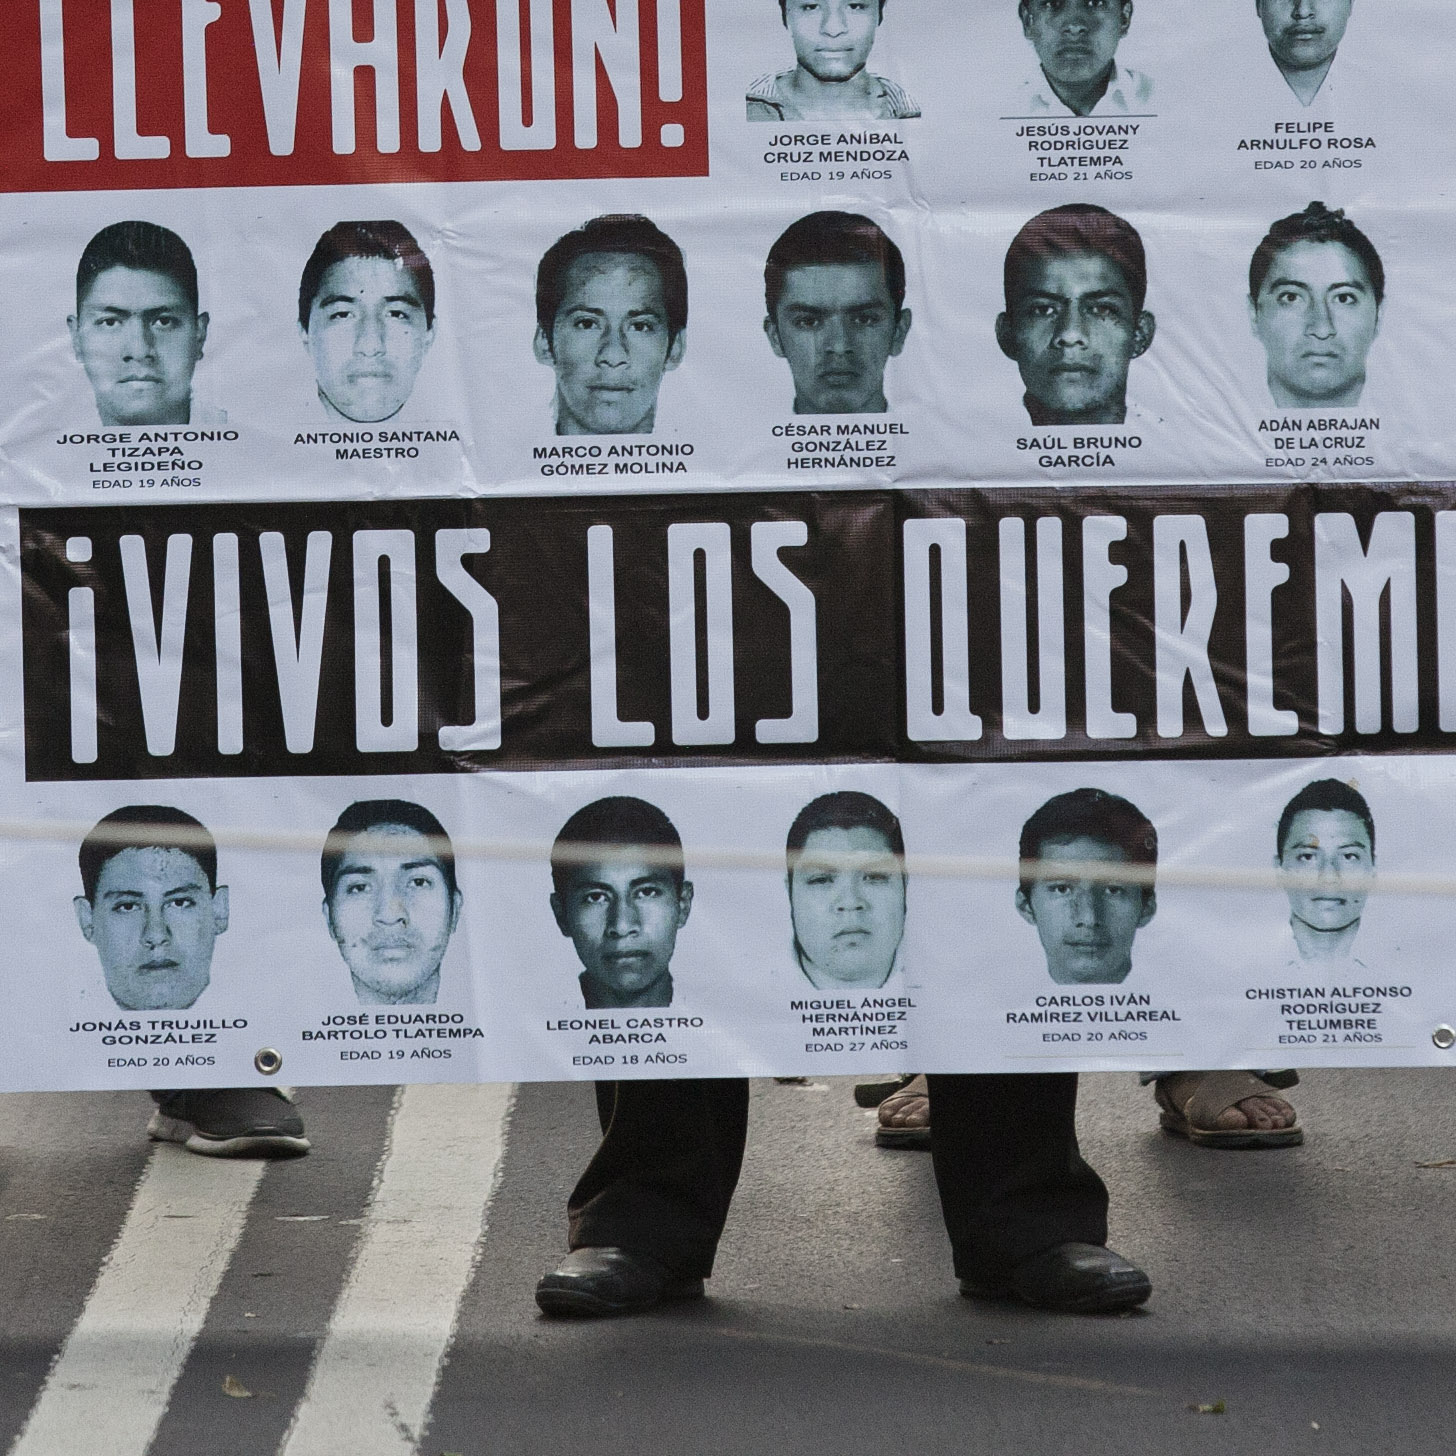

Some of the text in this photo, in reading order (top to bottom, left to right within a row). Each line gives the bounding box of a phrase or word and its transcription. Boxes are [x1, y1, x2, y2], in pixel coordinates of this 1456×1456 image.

[1015, 122, 1140, 137] JESÚS JOVANY
[1274, 122, 1335, 134] FELIPE
[768, 129, 904, 147] JORGE ANÍBAL
[1028, 136, 1129, 151] RODRÍGUEZ
[1236, 137, 1377, 150] ARNULFO ROSA
[763, 149, 910, 163] CRUZ MENDOZA
[1036, 156, 1124, 168] TLATEMPA
[1254, 157, 1363, 170] EDAD 20 AÑOS
[771, 422, 910, 437] CÉSAR MANUEL
[1258, 416, 1303, 432] ADÁN
[293, 430, 460, 444] ANTONIO SANTANA
[1016, 434, 1143, 450] SAÚL BRUNO
[1274, 435, 1366, 450] DE LA CRUZ
[533, 443, 695, 459] MARCO ANTONIO
[791, 437, 888, 453] GONZÁLEZ
[335, 447, 419, 459] MAESTRO
[1038, 451, 1116, 469] GARCÍA
[540, 459, 688, 476] GÓMEZ MOLINA
[787, 453, 897, 469] HERNÁNDEZ
[65, 527, 503, 764] ¡VIVOS
[586, 520, 820, 748] LOS
[1035, 992, 1151, 1007] CARLOS IVÁN
[1330, 986, 1413, 998] ALFONSO
[1280, 1000, 1382, 1015] RODRÍGUEZ
[546, 1016, 704, 1031] LEONEL CASTRO
[1006, 1009, 1182, 1024] RAMÍREZ VILLAREAL
[1285, 1018, 1377, 1030] TELUMBRE
[588, 1033, 667, 1045] ABARCA
[1278, 1029, 1383, 1044] EDAD 21 AÑOS
